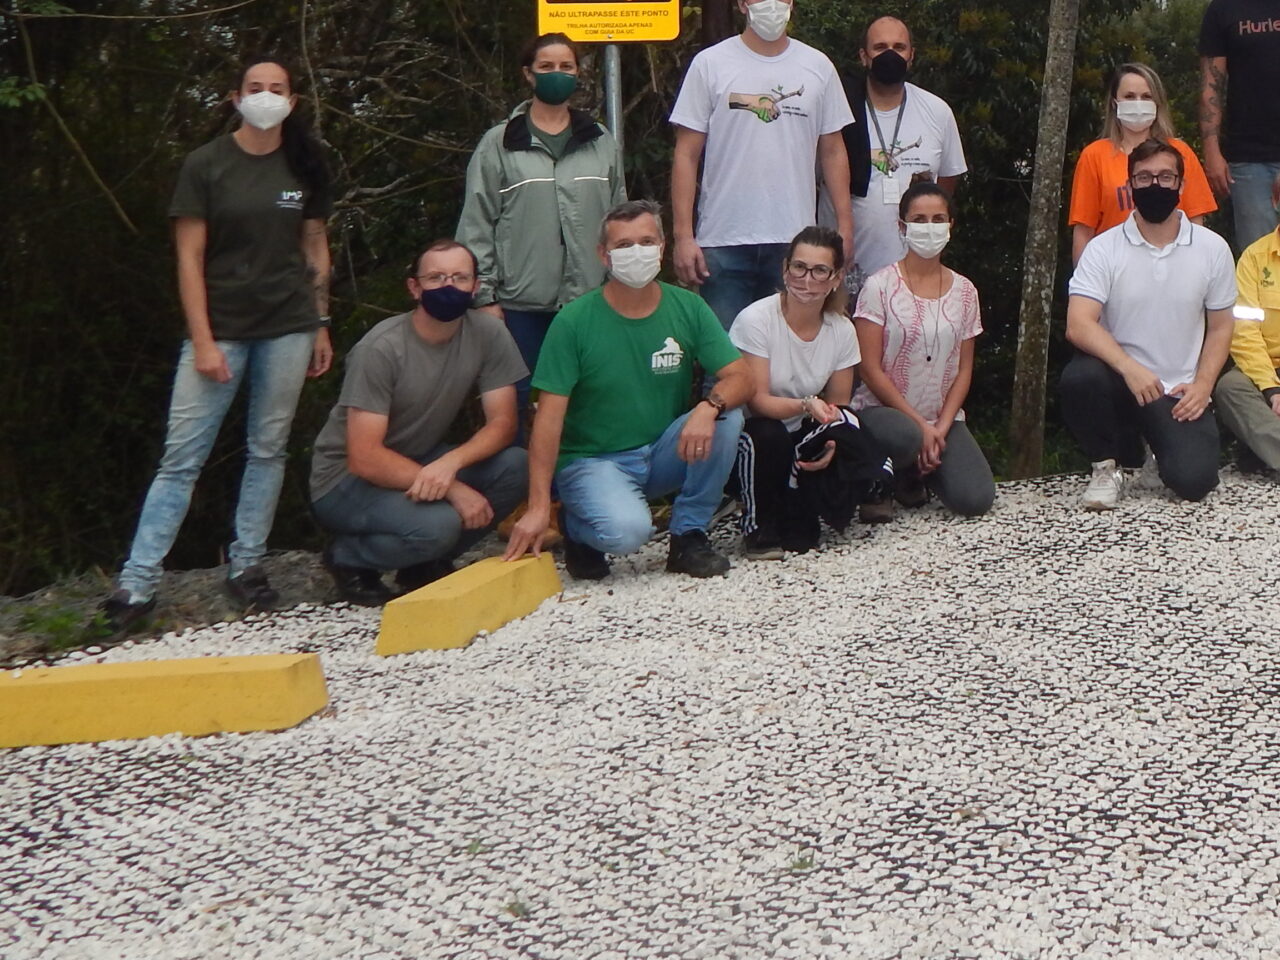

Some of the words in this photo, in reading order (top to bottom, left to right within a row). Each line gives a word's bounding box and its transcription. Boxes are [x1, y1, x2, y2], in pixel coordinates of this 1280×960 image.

[548, 10, 567, 18] NÃO
[568, 10, 618, 18] ULTRAPASSE
[652, 354, 683, 368] INIS
